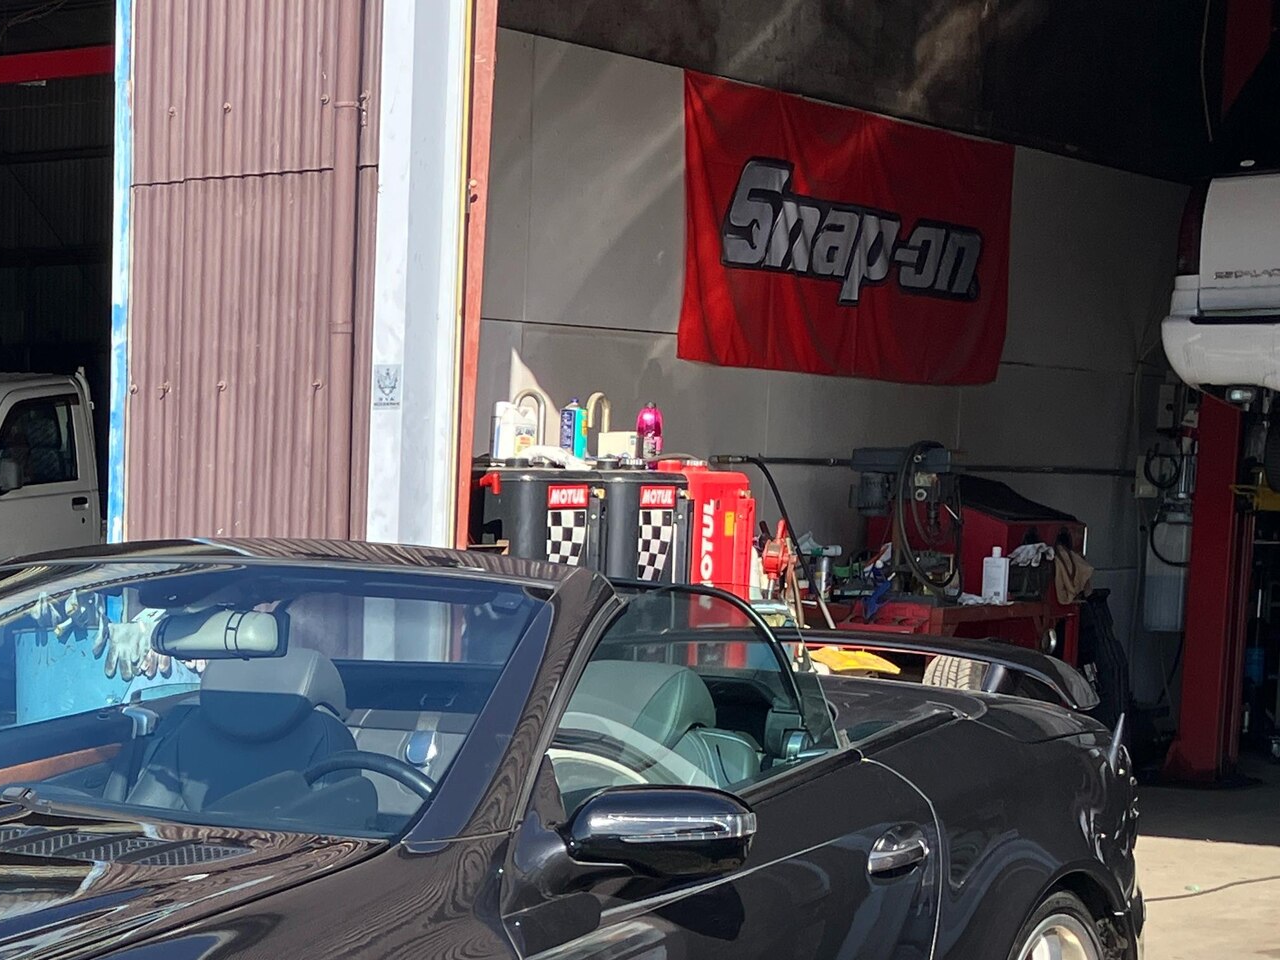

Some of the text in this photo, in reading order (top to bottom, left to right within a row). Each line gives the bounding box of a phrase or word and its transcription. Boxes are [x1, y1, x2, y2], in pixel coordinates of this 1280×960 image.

[722, 157, 982, 305] Snap-on
[550, 488, 586, 504] MOTUL
[641, 488, 673, 504] MOTUL
